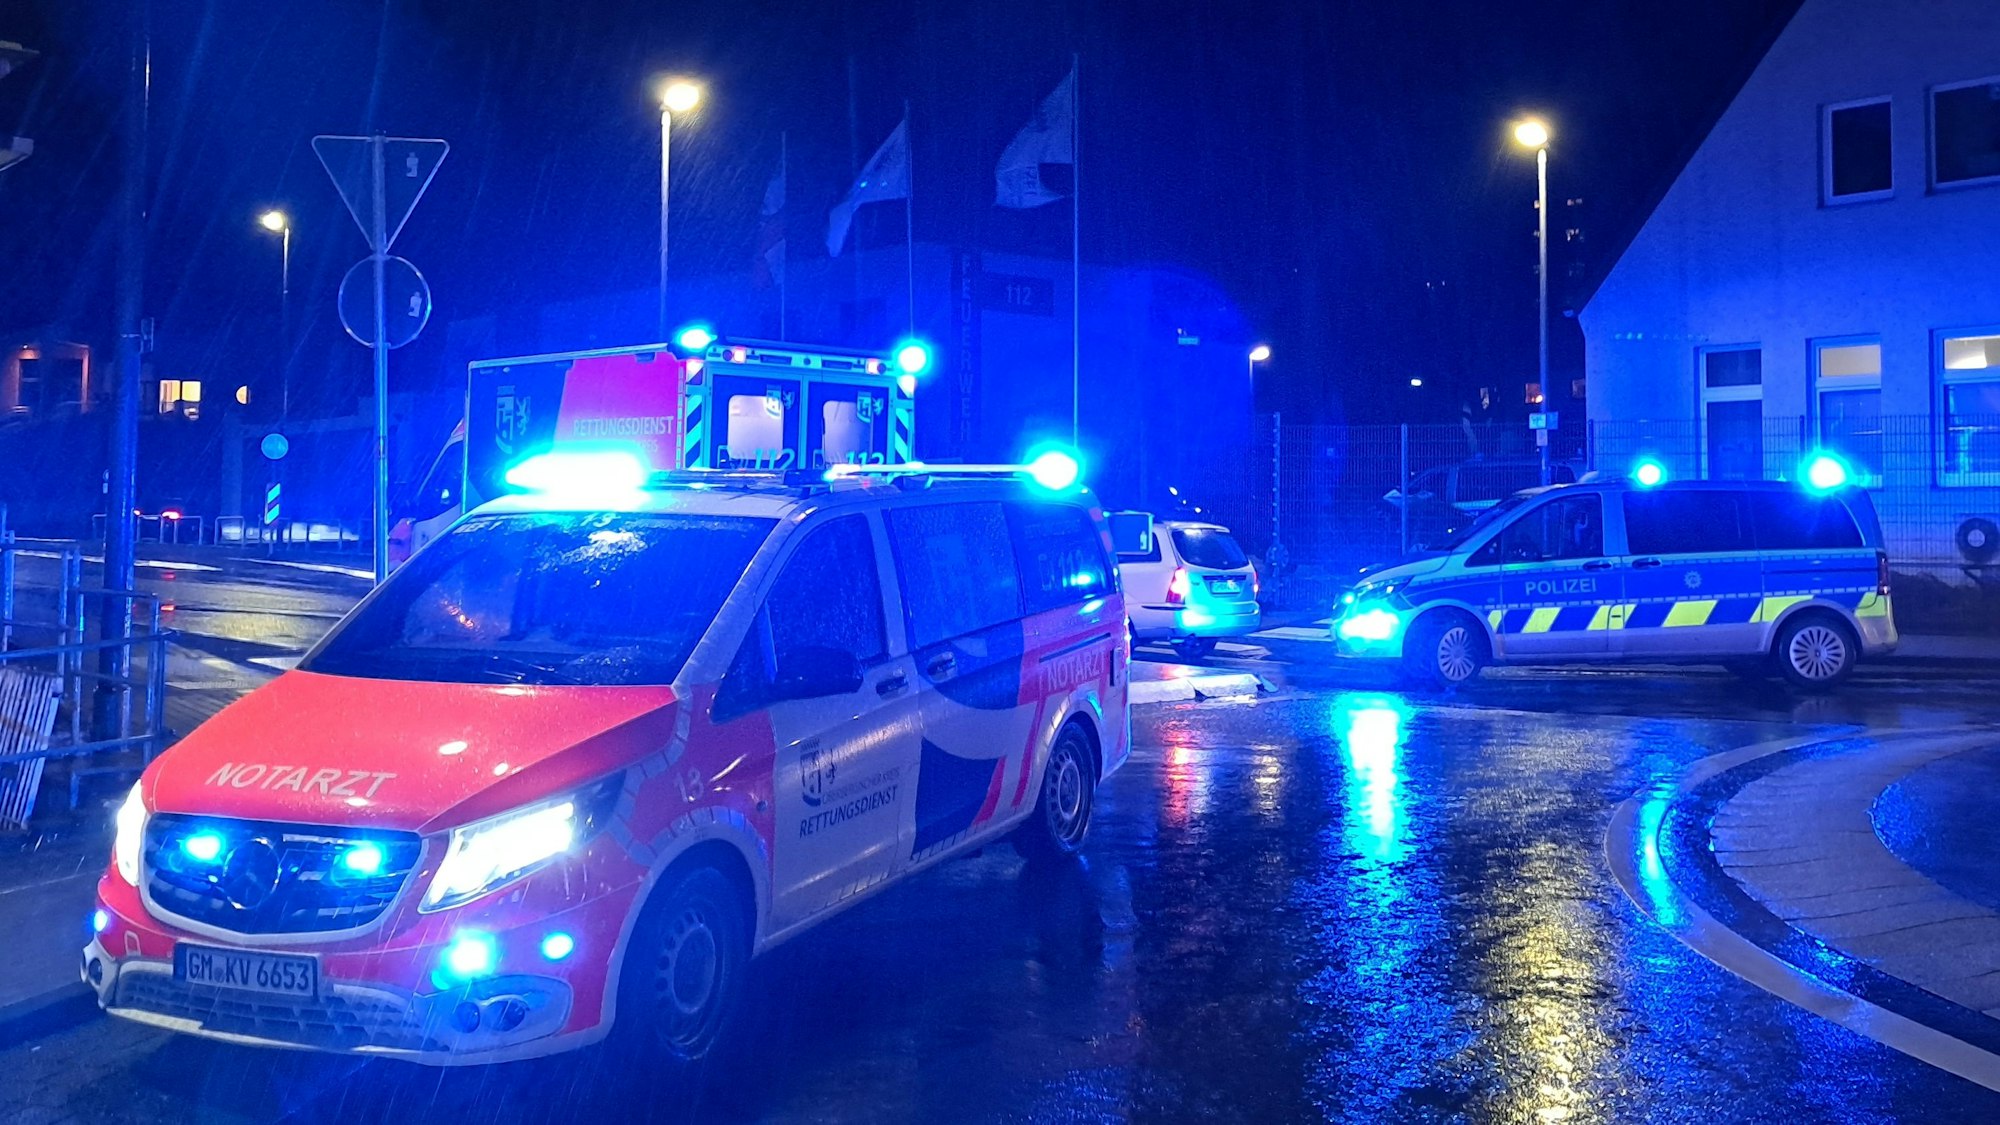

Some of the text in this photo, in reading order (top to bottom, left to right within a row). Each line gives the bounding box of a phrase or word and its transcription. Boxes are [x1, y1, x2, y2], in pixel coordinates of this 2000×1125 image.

[1006, 284, 1033, 306] 112
[573, 415, 674, 437] RETTUNGSDIENST
[752, 447, 795, 470] 112
[1524, 577, 1597, 596] POLIZEI
[1047, 650, 1106, 692] NOTARZT
[204, 762, 398, 798] NOTARZT
[800, 784, 898, 839] RETTUNGSDIENST
[188, 952, 309, 990] GM KV 6653
